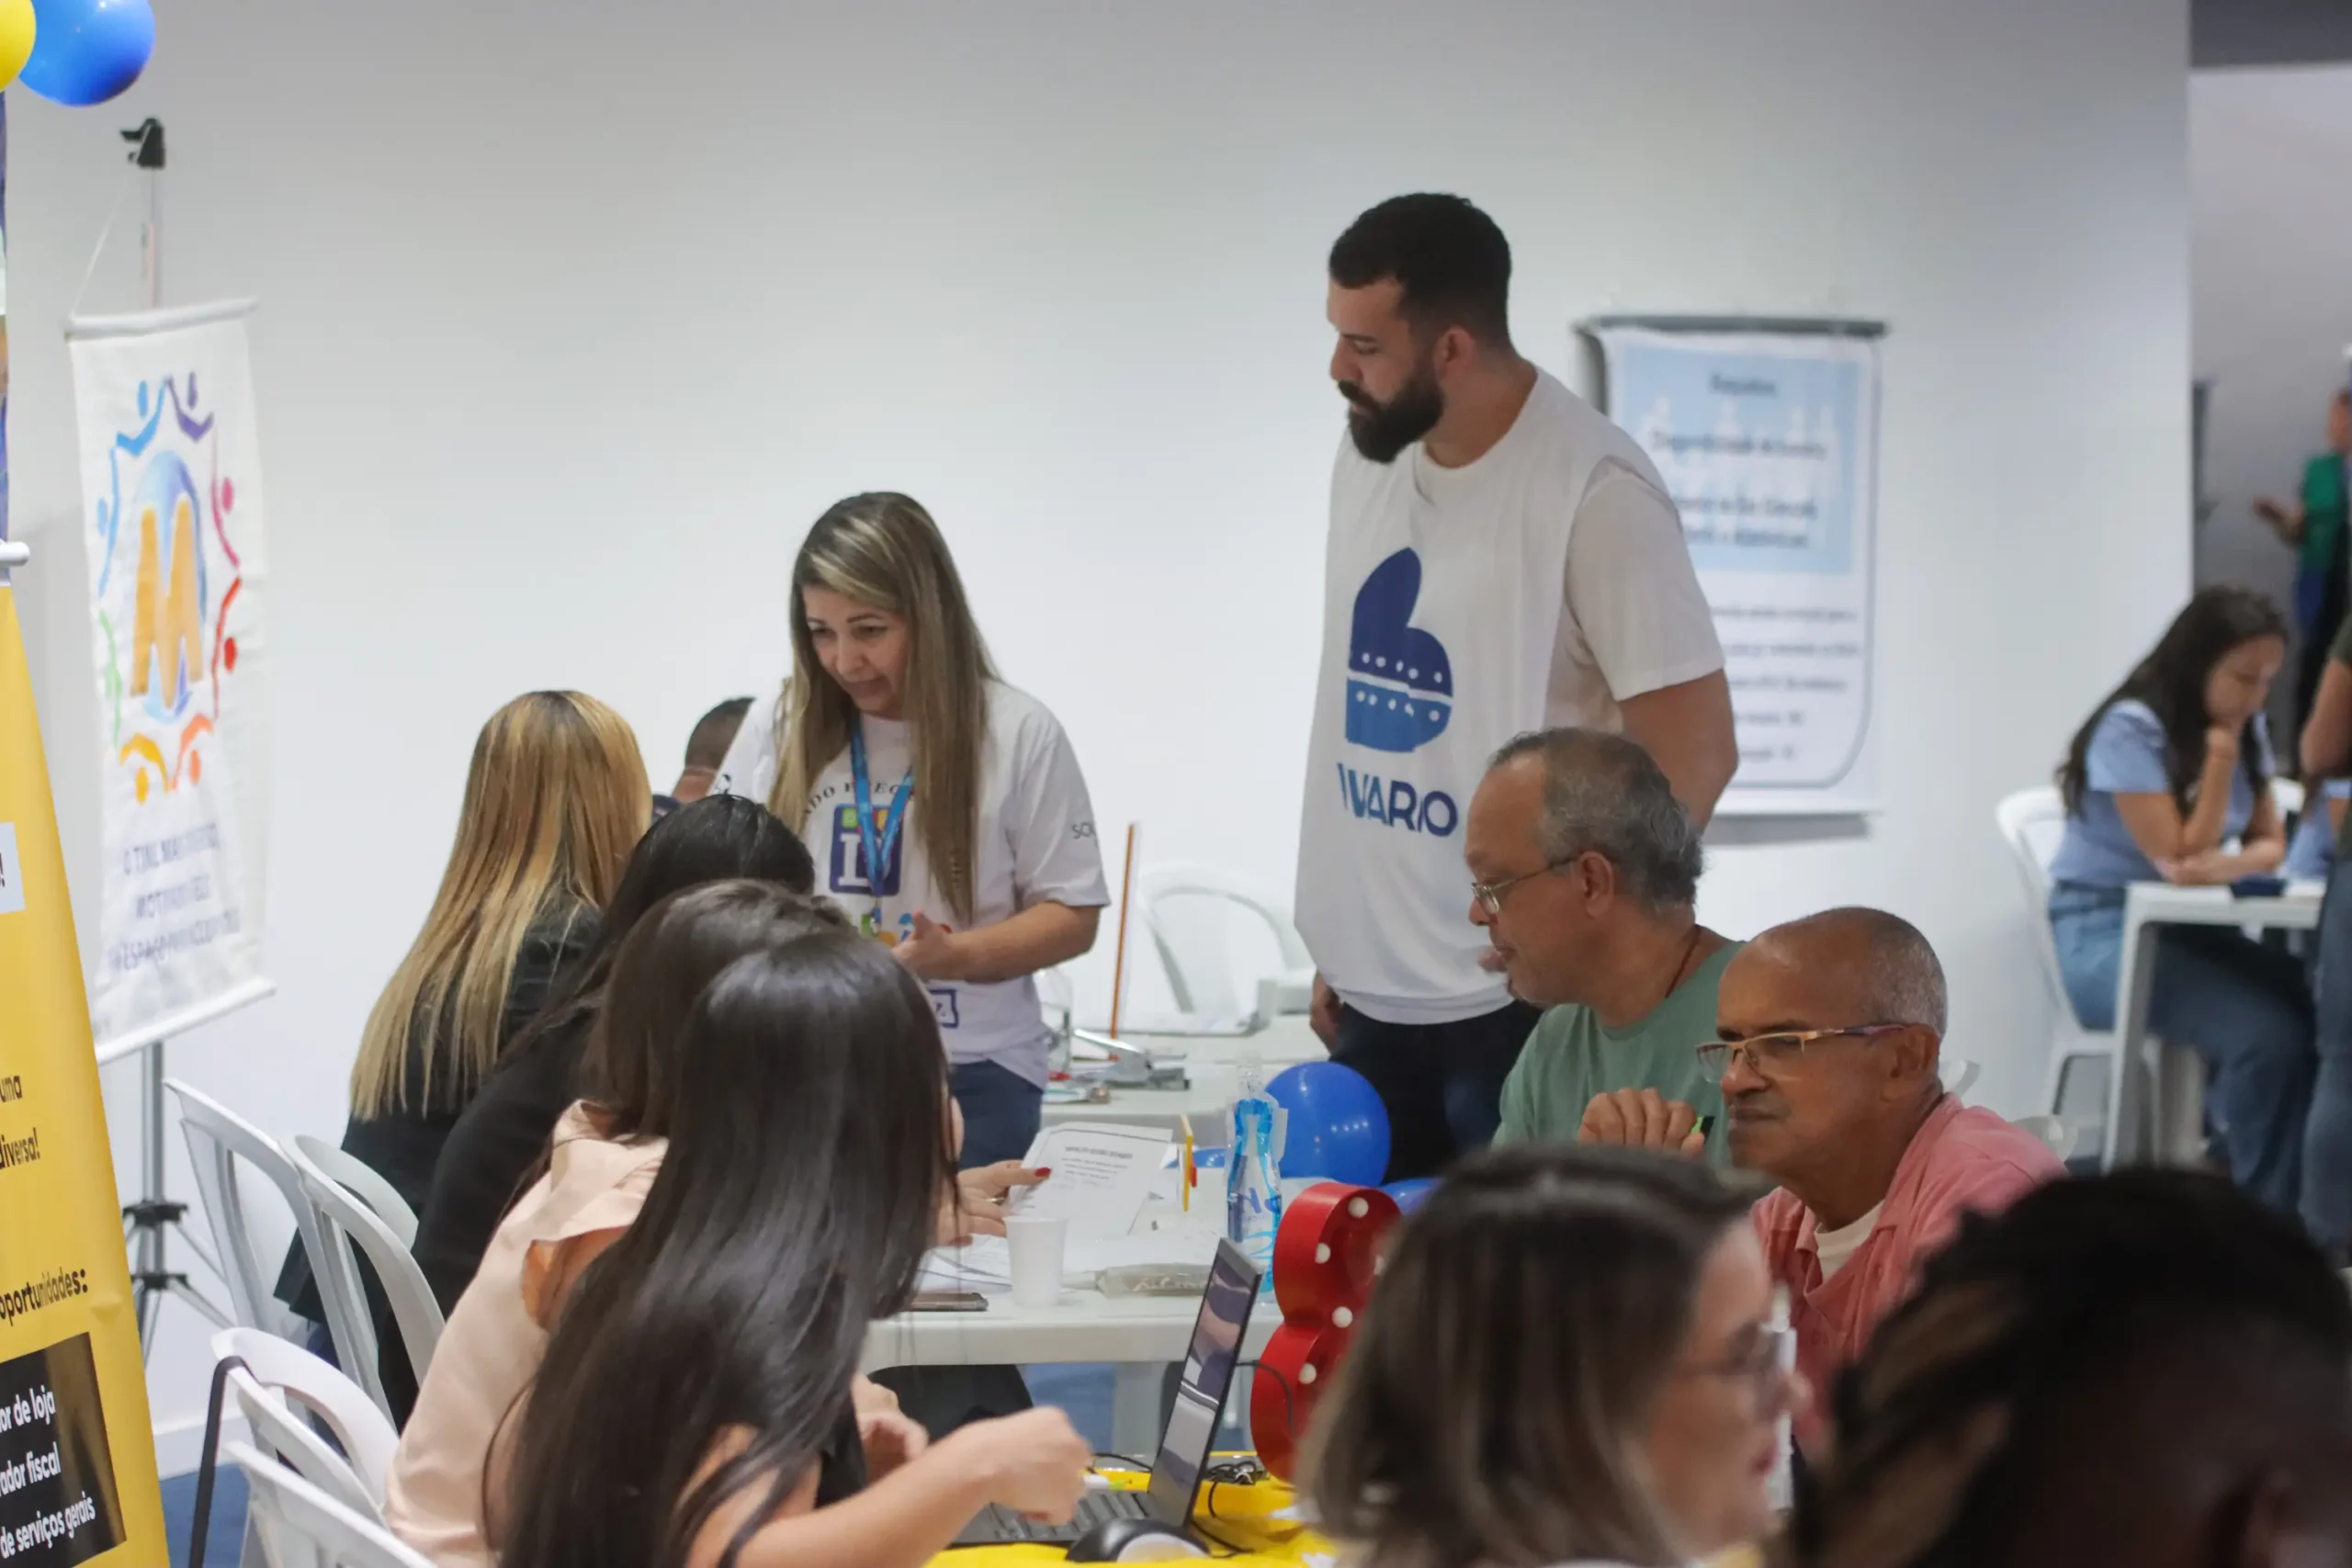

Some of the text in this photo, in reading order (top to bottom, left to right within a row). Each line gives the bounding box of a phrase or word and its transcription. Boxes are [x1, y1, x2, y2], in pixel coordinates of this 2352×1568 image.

[13, 1393, 31, 1427] de
[29, 1384, 56, 1425] loja
[0, 1440, 62, 1497] ador fiscal
[0, 1490, 96, 1559] de serviços gerais
